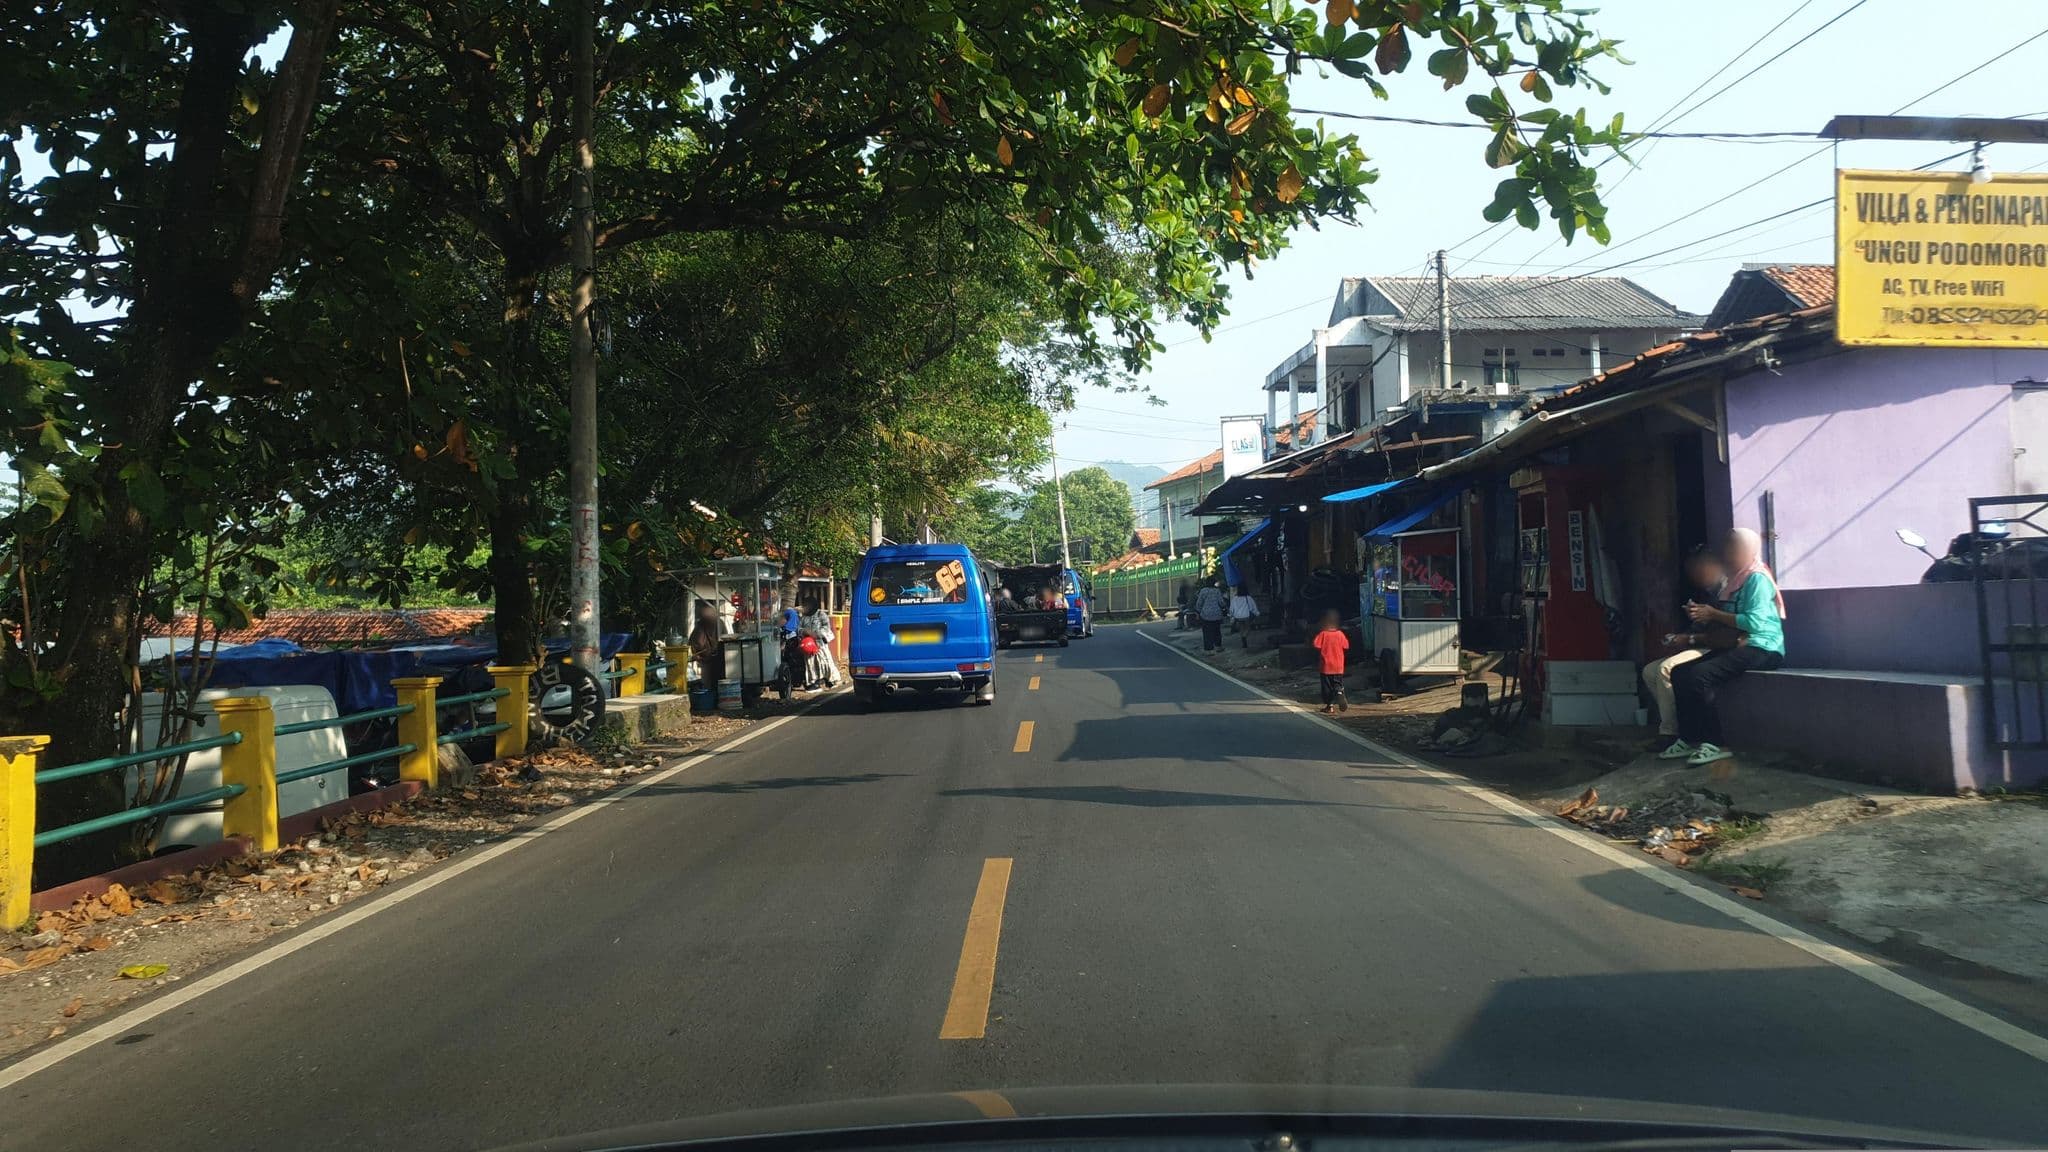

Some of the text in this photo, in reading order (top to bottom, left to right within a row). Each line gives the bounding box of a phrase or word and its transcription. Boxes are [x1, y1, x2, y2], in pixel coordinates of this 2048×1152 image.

[1856, 192, 2048, 227] VILLA & PENGINAPA
[1934, 280, 1967, 296] Free
[1971, 280, 2004, 297] WiFi
[1569, 513, 1585, 589] BENSIN
